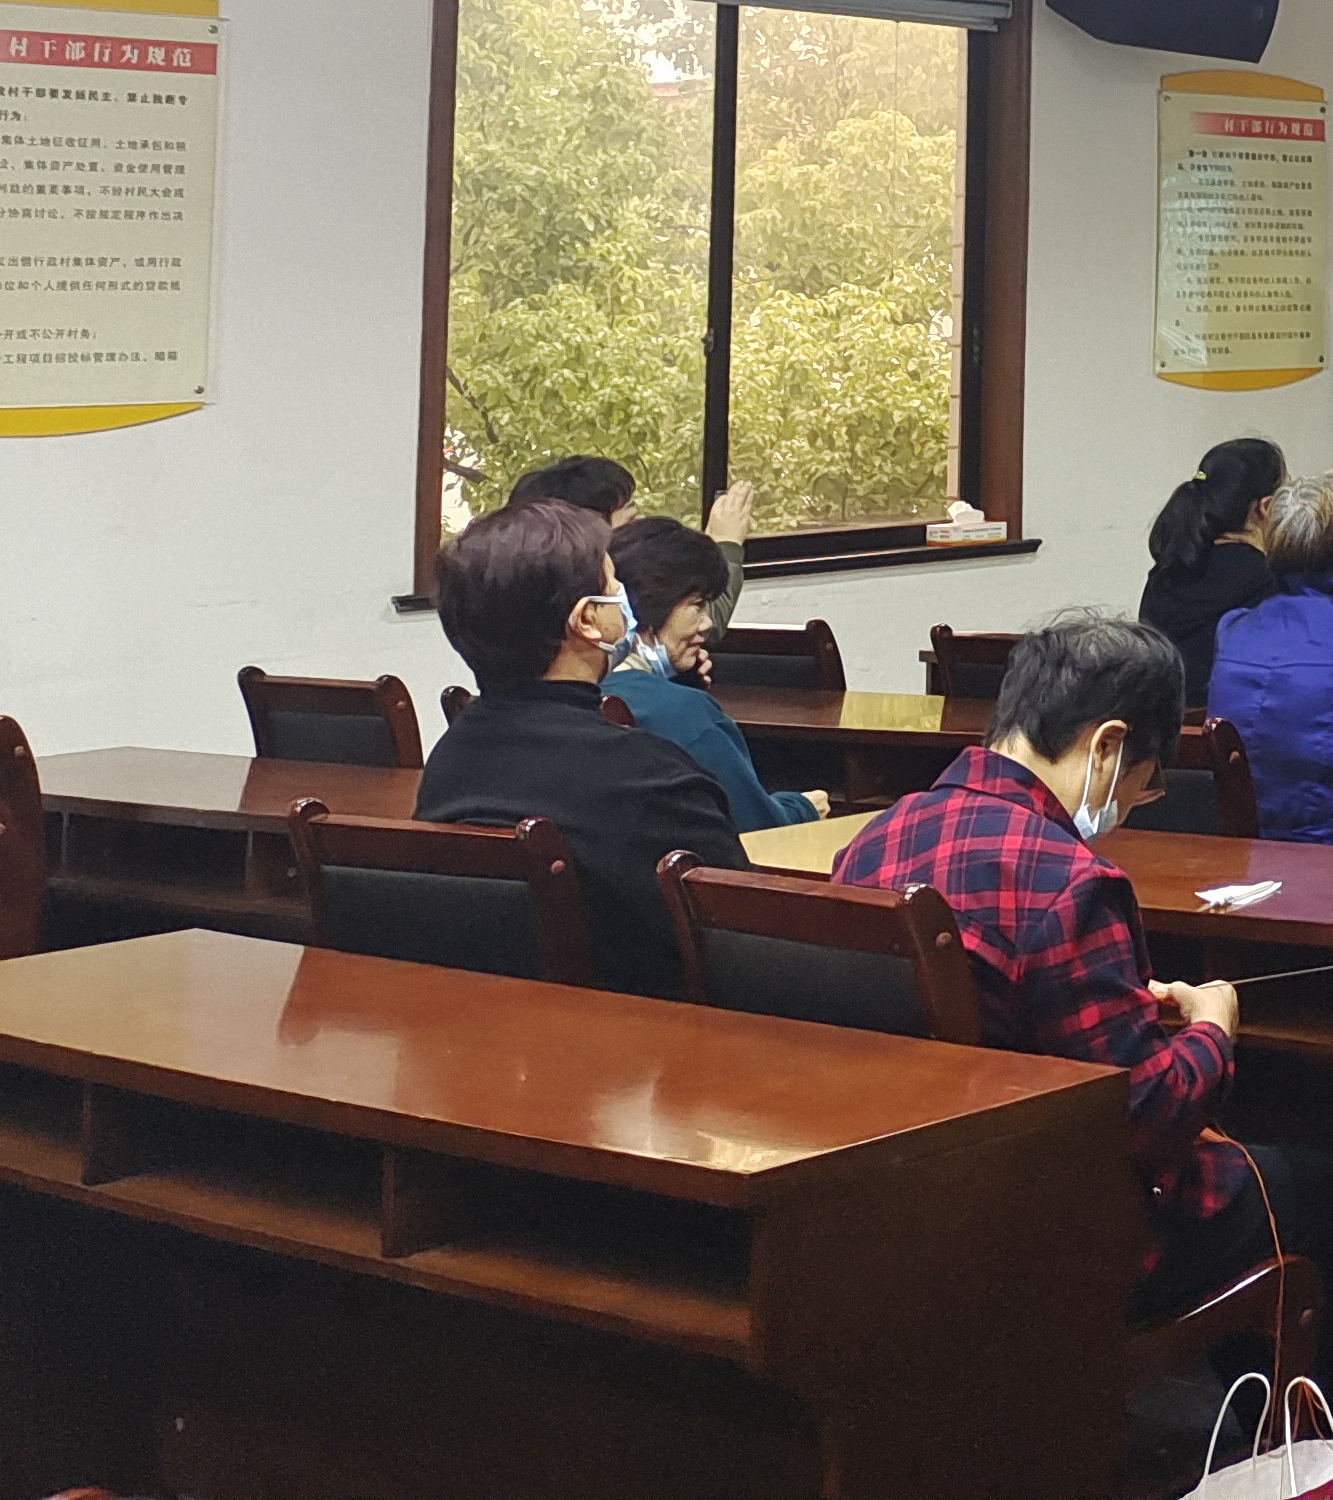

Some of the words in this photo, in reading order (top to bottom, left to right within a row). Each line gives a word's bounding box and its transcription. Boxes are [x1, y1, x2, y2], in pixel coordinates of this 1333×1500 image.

[10, 36, 192, 67] 村干部行为规范
